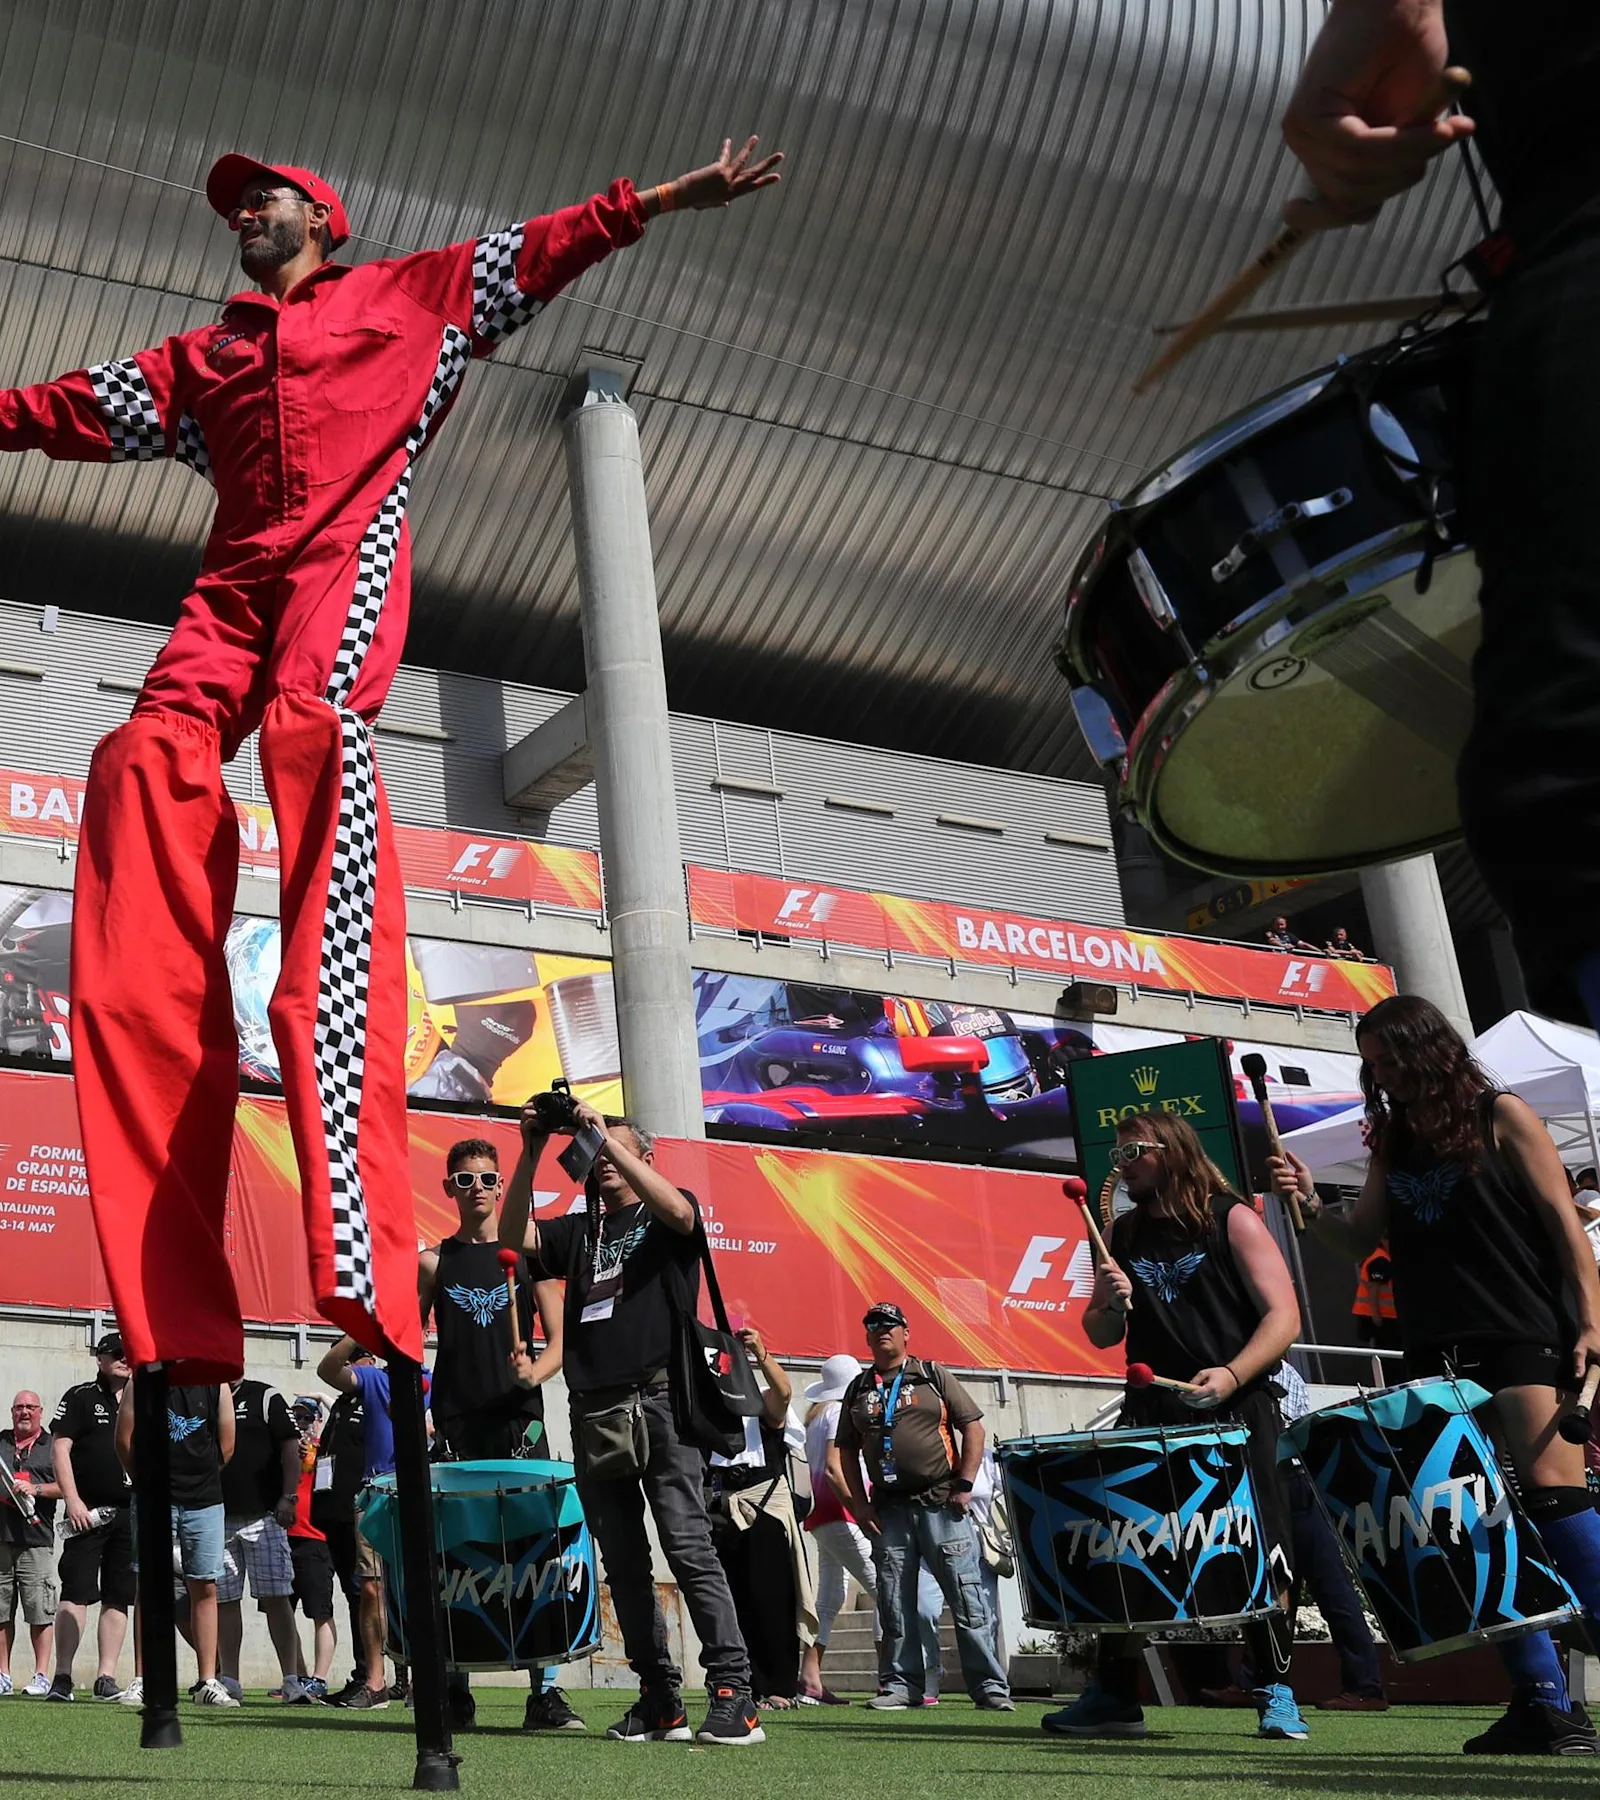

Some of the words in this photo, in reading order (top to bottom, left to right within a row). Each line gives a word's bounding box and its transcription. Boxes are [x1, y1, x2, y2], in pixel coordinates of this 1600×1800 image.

[446, 874, 481, 885] Formula
[956, 916, 1167, 975] BARCELONA
[16, 1161, 64, 1177] GRAN
[6, 1178, 26, 1192] DE
[31, 1178, 91, 1197] ESPAÑA
[708, 1206, 714, 1218] 1
[29, 1221, 56, 1233] MAY
[747, 1240, 777, 1254] 2017
[1002, 1296, 1056, 1311] Formula
[1057, 1301, 1067, 1312] 1
[1064, 1505, 1252, 1565] TUKANTU
